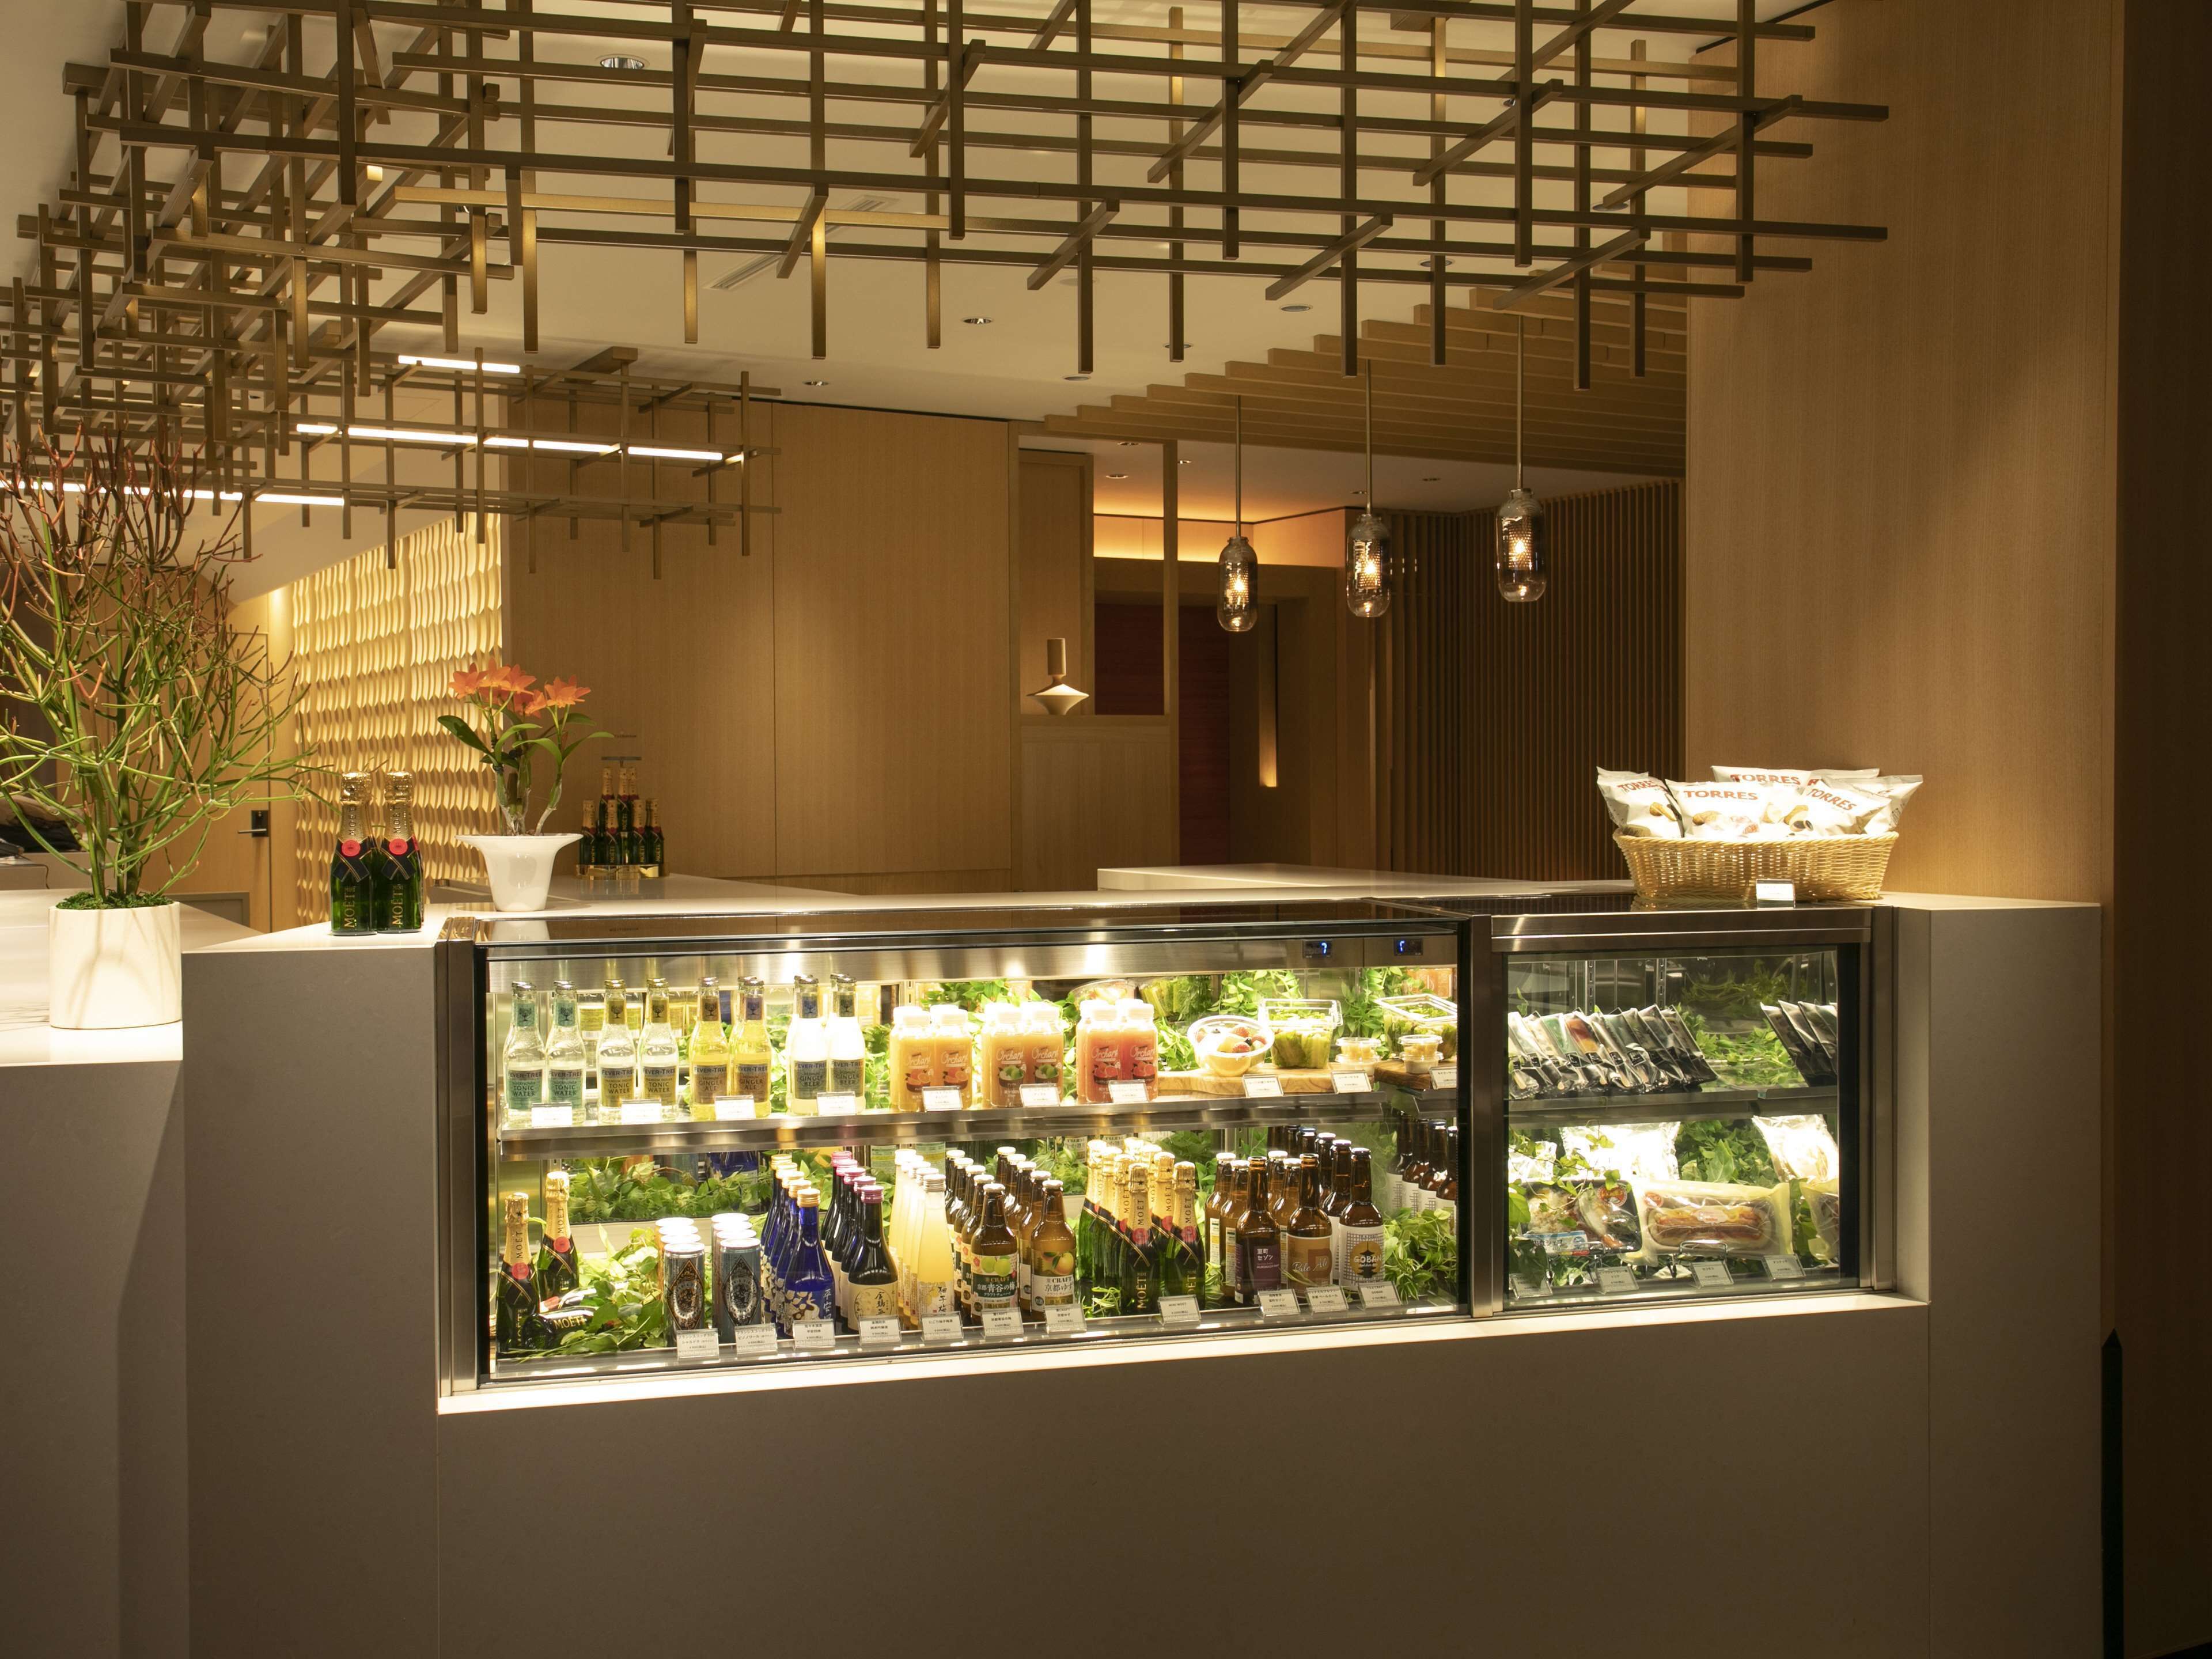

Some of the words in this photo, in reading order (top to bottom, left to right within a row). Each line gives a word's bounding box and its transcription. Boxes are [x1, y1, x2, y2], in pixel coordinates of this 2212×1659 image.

[1730, 774, 1801, 785] TORRES
[1683, 790, 1759, 801] TORRES
[1806, 788, 1857, 811] TORRES
[342, 893, 355, 928] MOËT
[391, 892, 403, 926] MOËT
[515, 1232, 523, 1259] MOËT
[1291, 1262, 1310, 1272] Pale
[1135, 1277, 1147, 1309] MOËT
